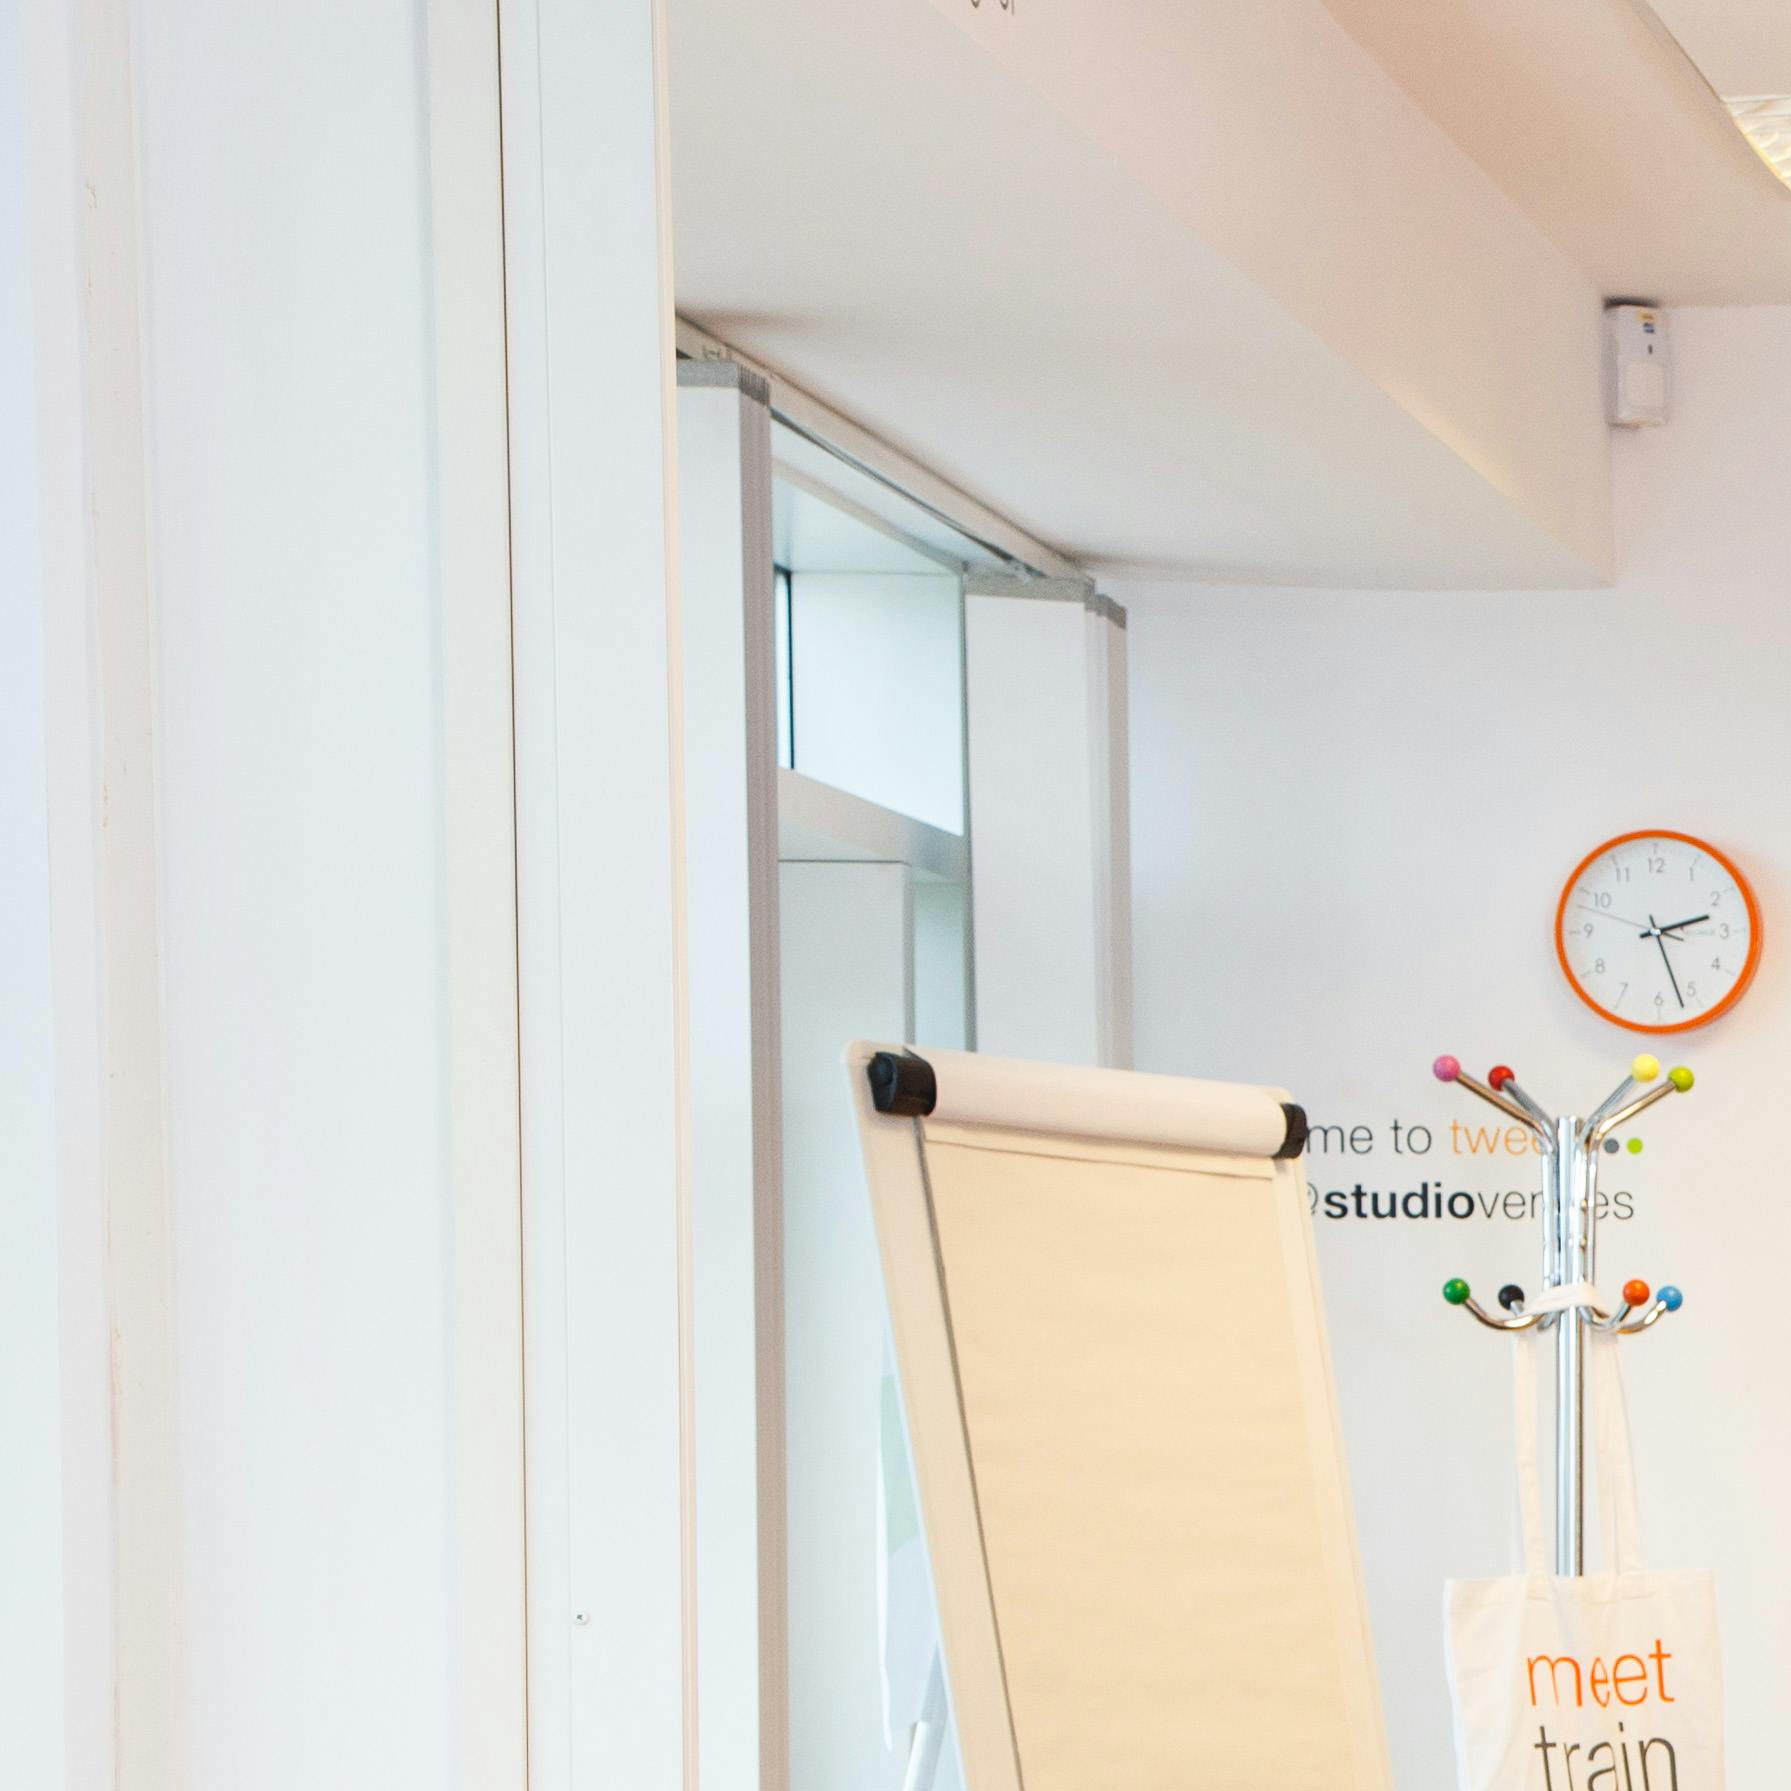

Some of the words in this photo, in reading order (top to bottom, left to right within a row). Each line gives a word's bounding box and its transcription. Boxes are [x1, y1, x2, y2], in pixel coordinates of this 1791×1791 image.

[1648, 857, 1665, 873] 12
[1615, 867, 1631, 883] 11
[1594, 892, 1612, 908] 10
[1710, 891, 1721, 907] 2
[1583, 923, 1594, 939] 9
[1719, 923, 1729, 939] 3
[1594, 959, 1606, 974] 8
[1710, 957, 1721, 970] 4
[1687, 981, 1697, 997] 5
[1653, 991, 1664, 1006] 6
[1390, 1117, 1433, 1155] to
[1526, 1638, 1676, 1708] meet
